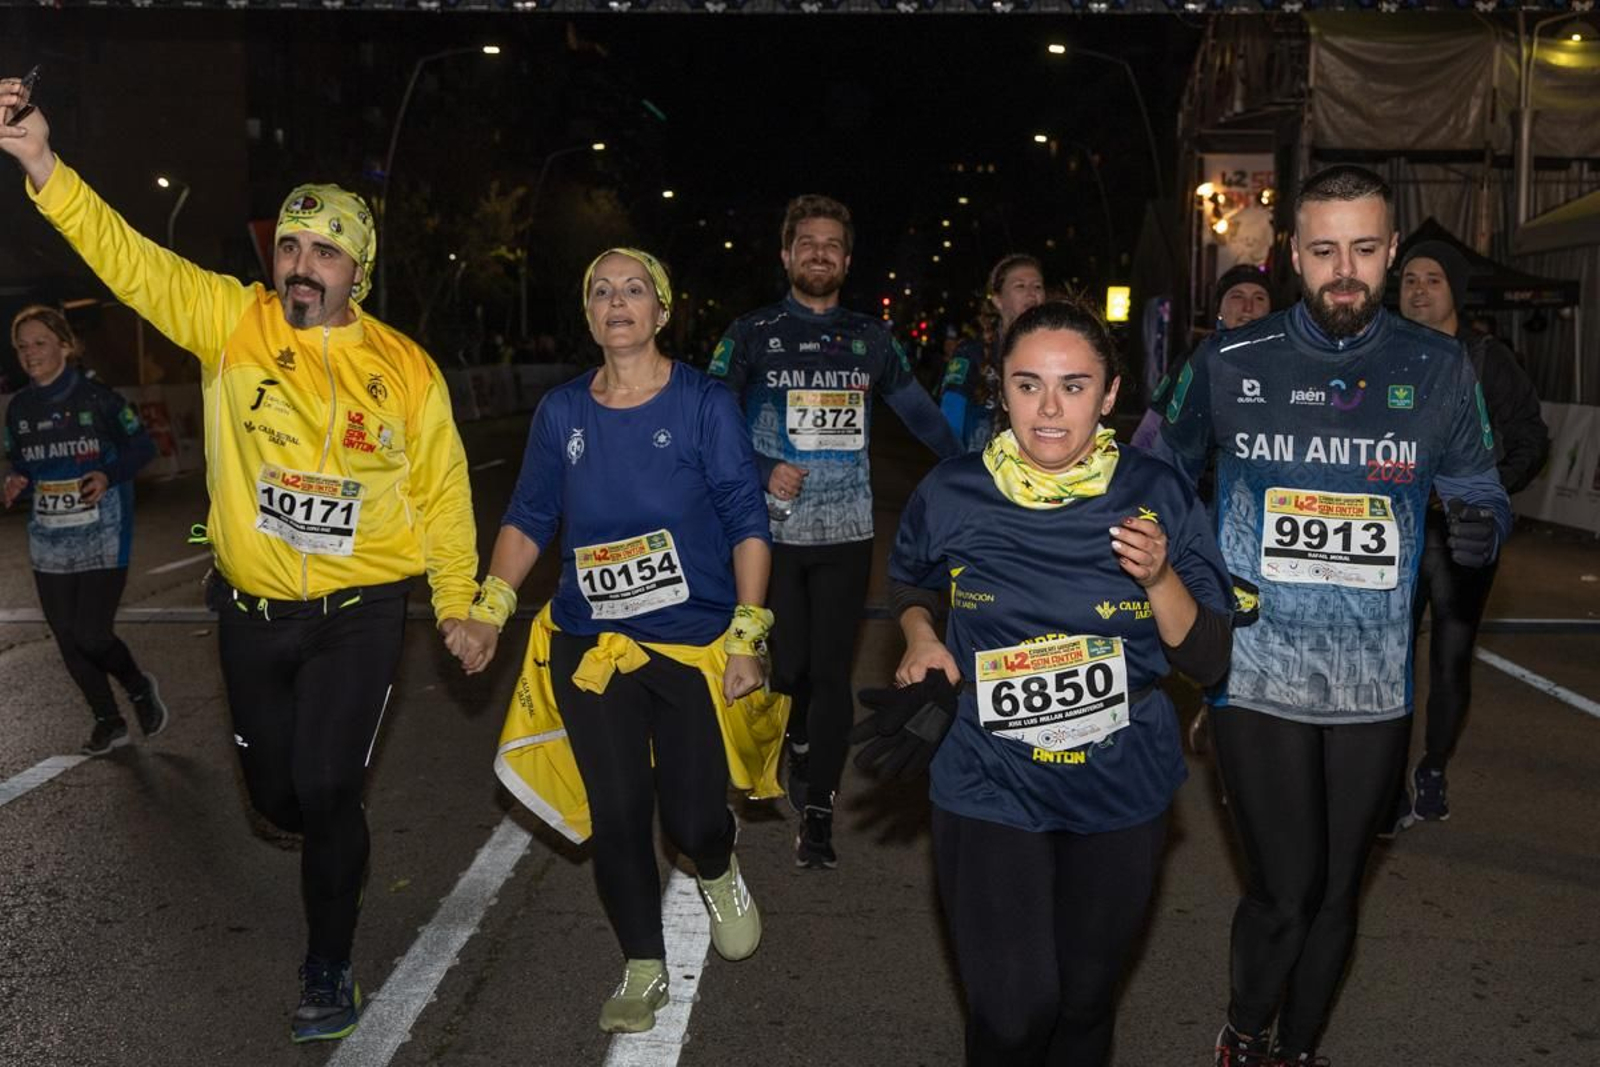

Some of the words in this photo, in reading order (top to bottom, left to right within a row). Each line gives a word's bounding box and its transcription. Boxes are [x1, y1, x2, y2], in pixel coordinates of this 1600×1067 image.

[766, 370, 805, 388] SAN
[811, 367, 870, 389] ANTÓN
[796, 408, 857, 428] 7872
[1235, 432, 1294, 462] SAN
[1305, 432, 1417, 469] ANTÓN
[281, 472, 301, 488] 42
[1367, 460, 1418, 484] 2025
[262, 487, 354, 525] 10171
[1294, 495, 1317, 512] 42
[1275, 516, 1387, 554] 9913
[593, 548, 610, 562] 42
[583, 552, 677, 593] 10154
[1003, 652, 1030, 671] 42
[1031, 657, 1050, 669] SAN
[1051, 650, 1083, 664] ANTON
[992, 662, 1113, 718] 6850
[1024, 717, 1038, 725] LUIS
[1032, 747, 1086, 764] ANTON
